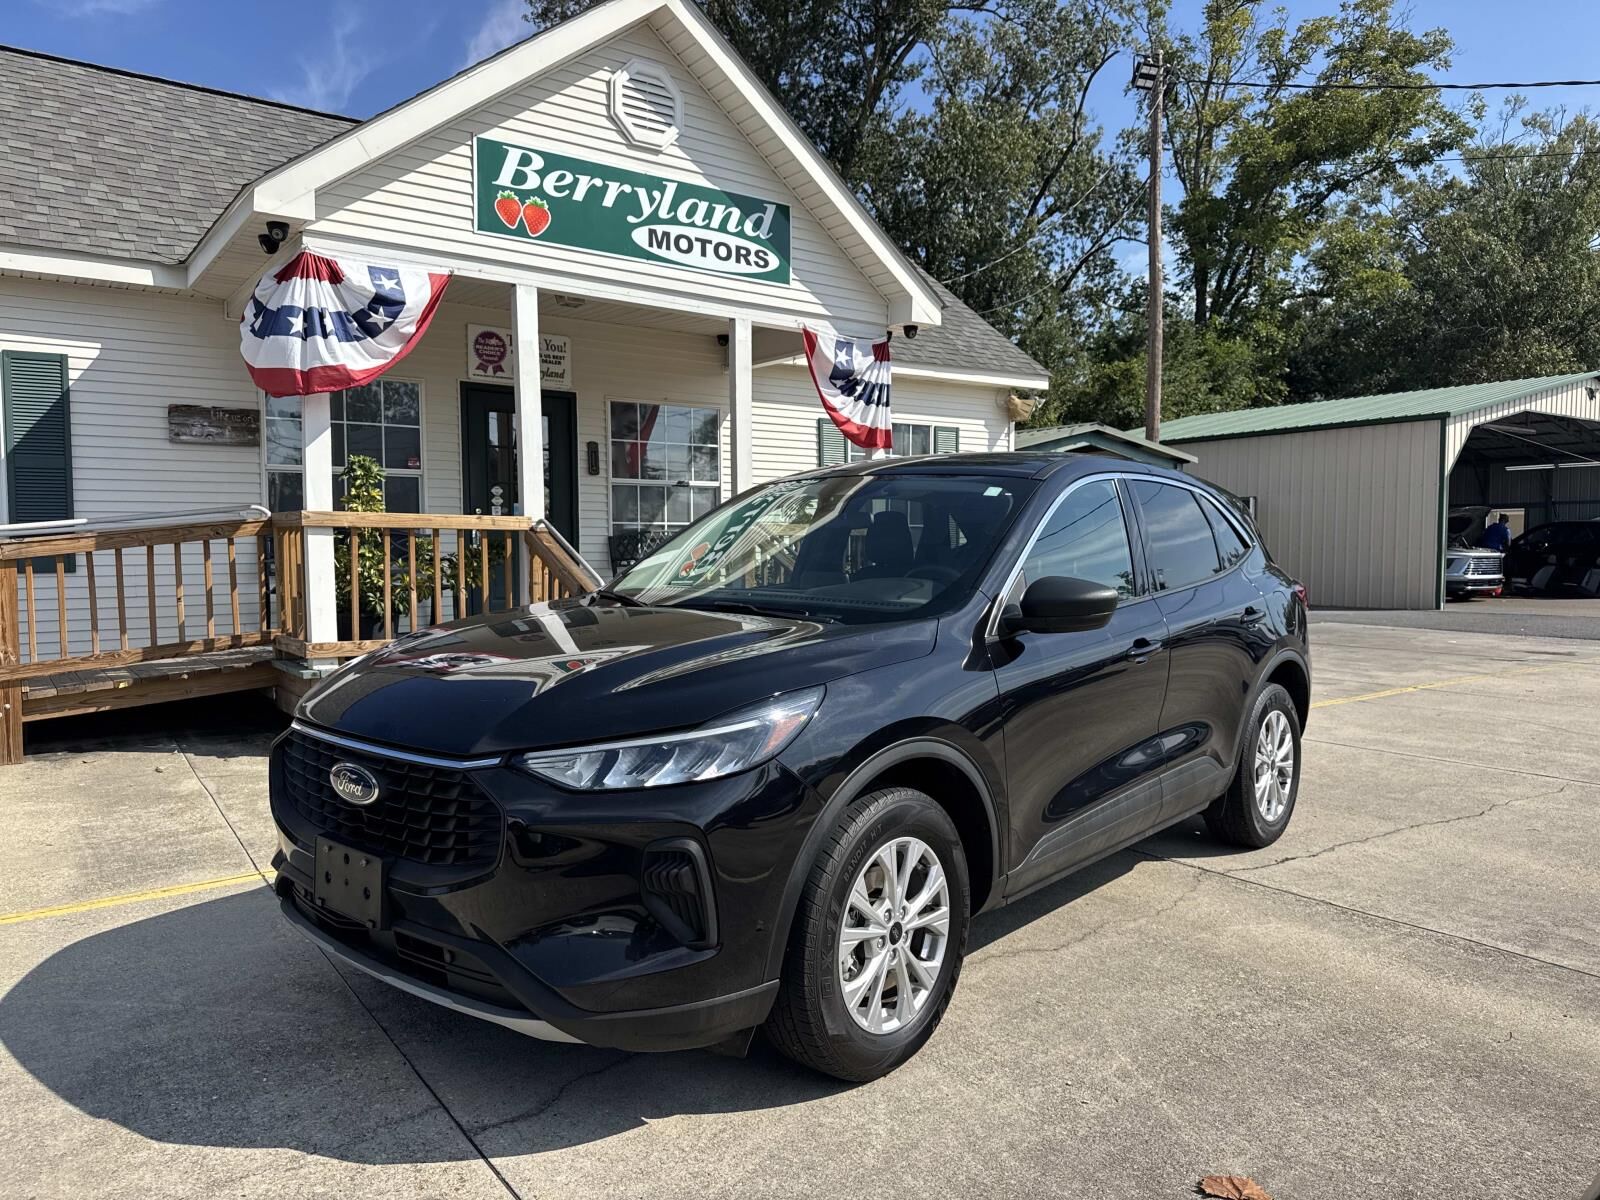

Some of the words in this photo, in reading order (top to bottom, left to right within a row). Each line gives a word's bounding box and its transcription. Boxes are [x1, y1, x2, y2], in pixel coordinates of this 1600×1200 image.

[492, 145, 777, 240] Berryland
[647, 227, 770, 269] MOTORS
[544, 338, 566, 353] You!
[338, 771, 363, 796] Ford
[844, 840, 868, 883] BANDIT
